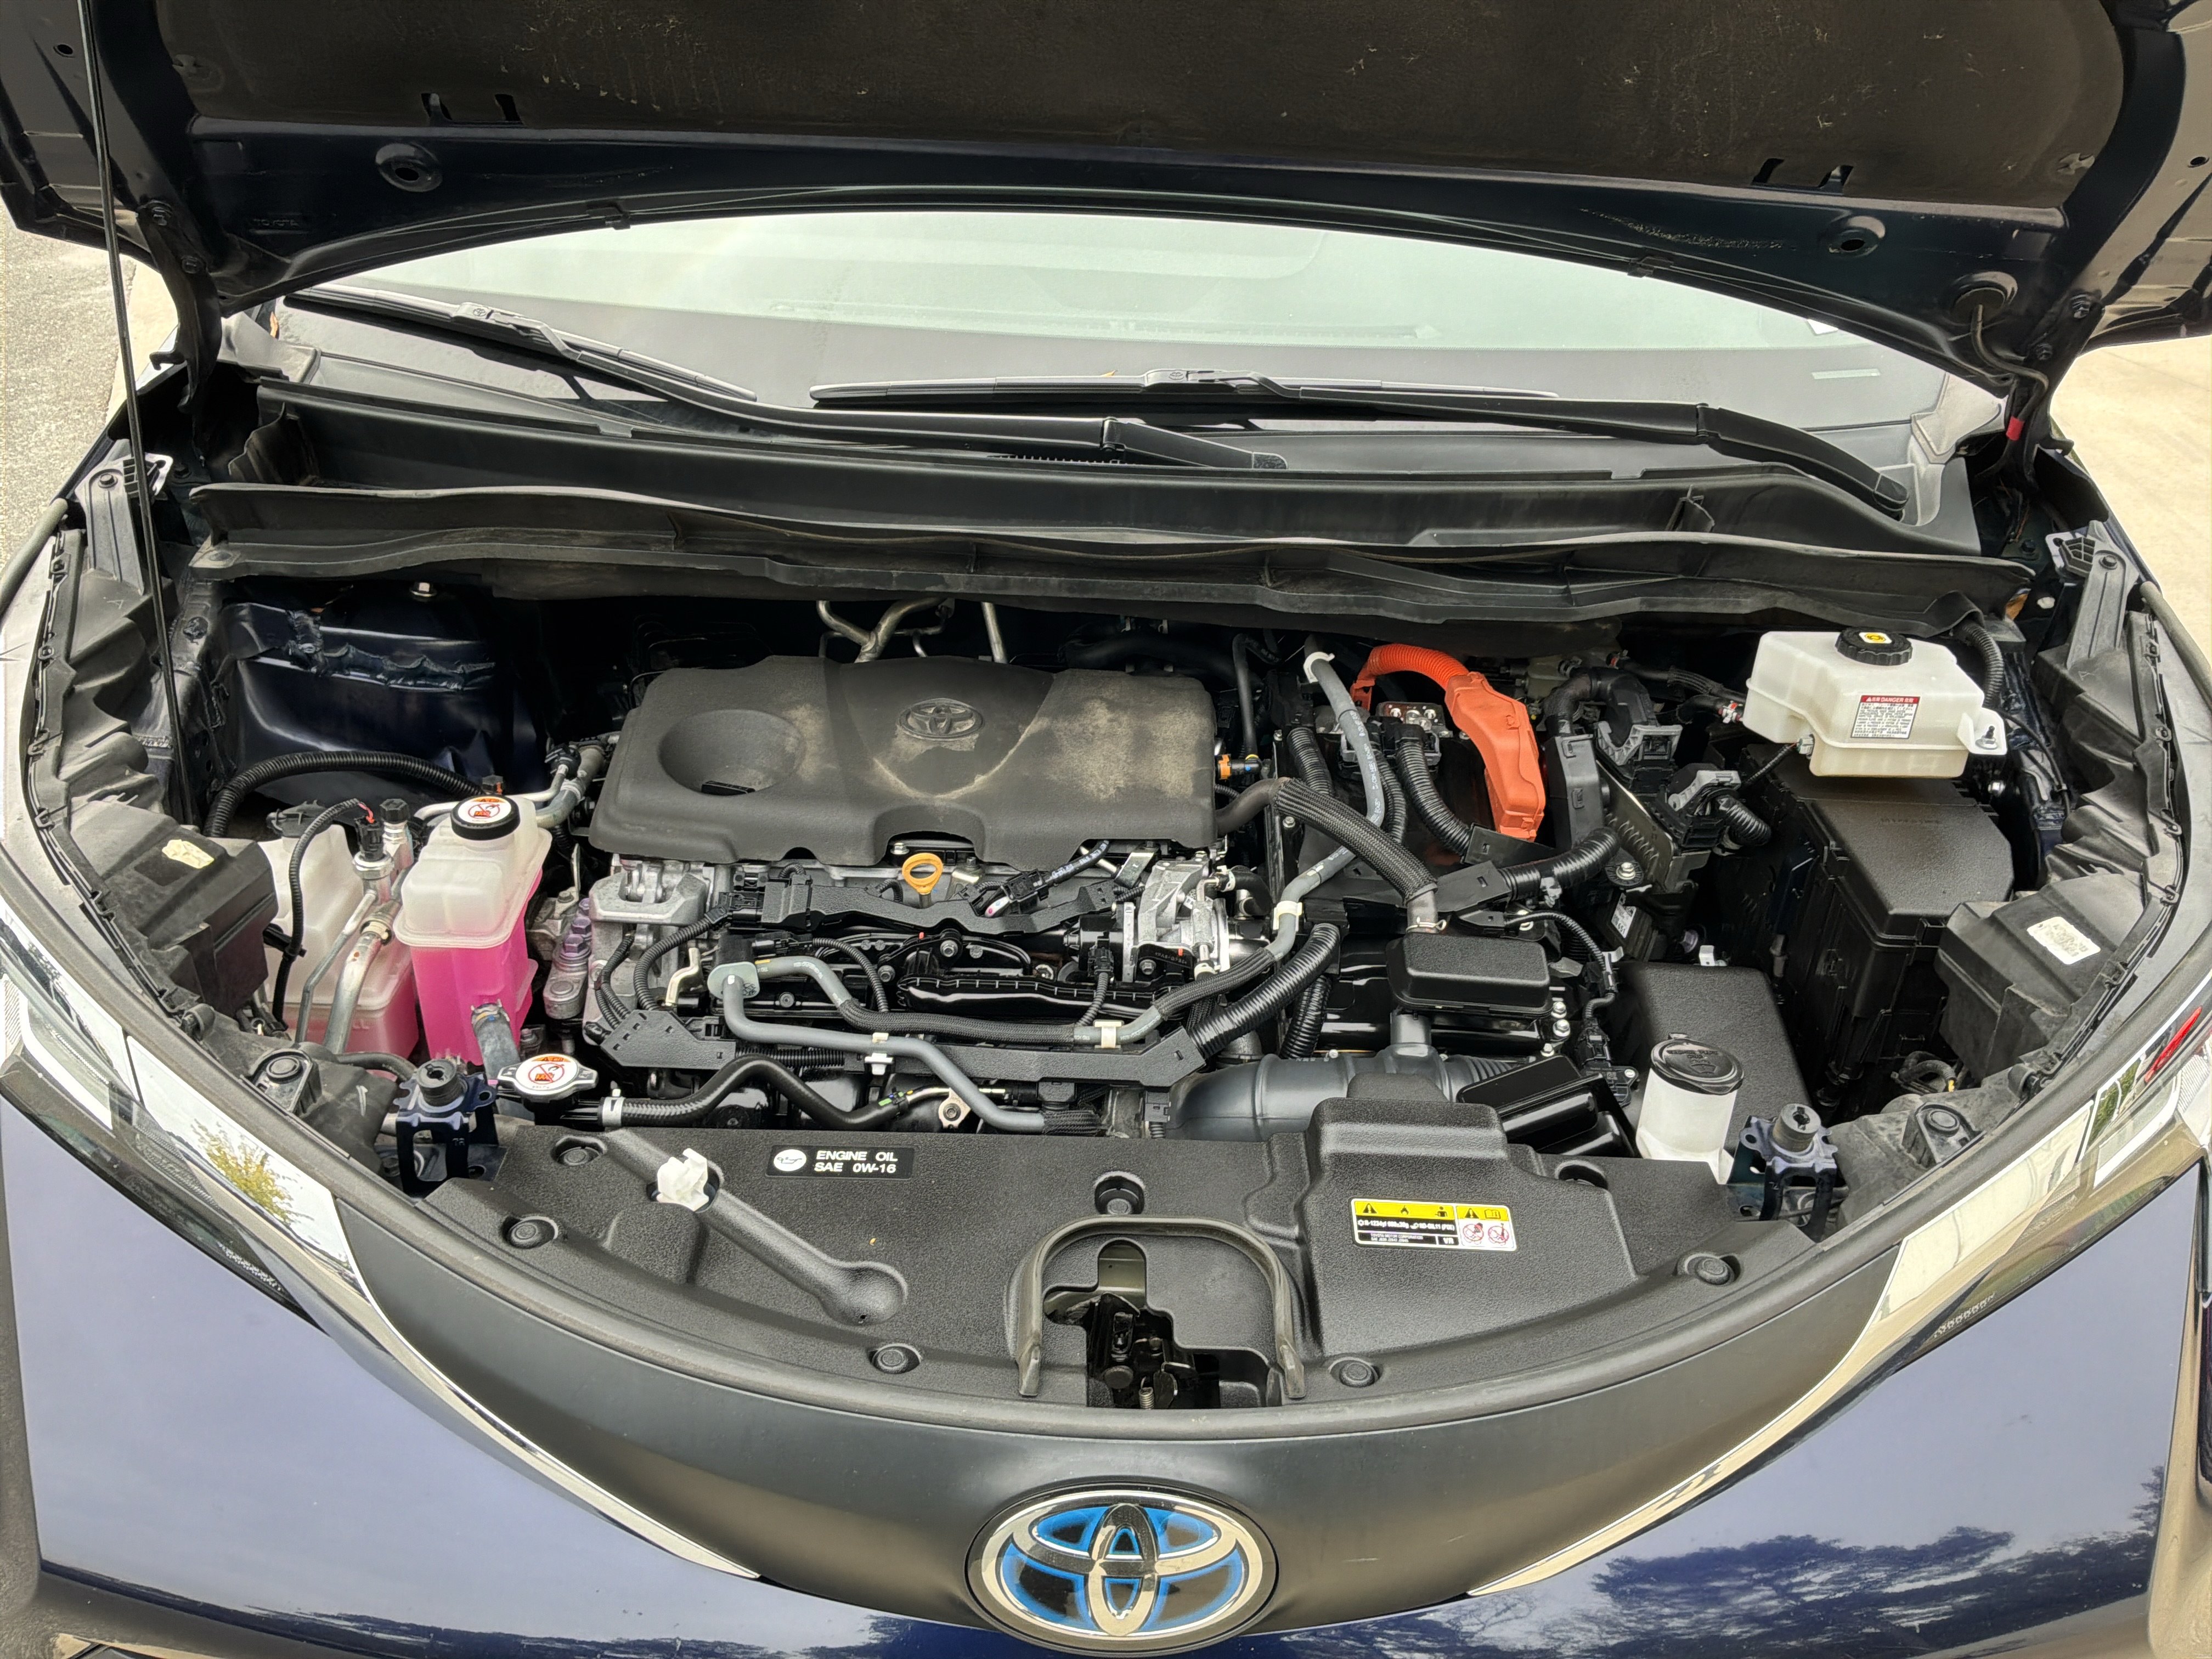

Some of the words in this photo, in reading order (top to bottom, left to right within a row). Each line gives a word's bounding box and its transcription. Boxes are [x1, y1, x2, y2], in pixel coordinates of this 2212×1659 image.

[816, 1150, 868, 1161] ENGINE
[875, 1151, 899, 1163] OIL
[814, 1162, 843, 1172] SAE
[852, 1163, 897, 1174] 0W-16
